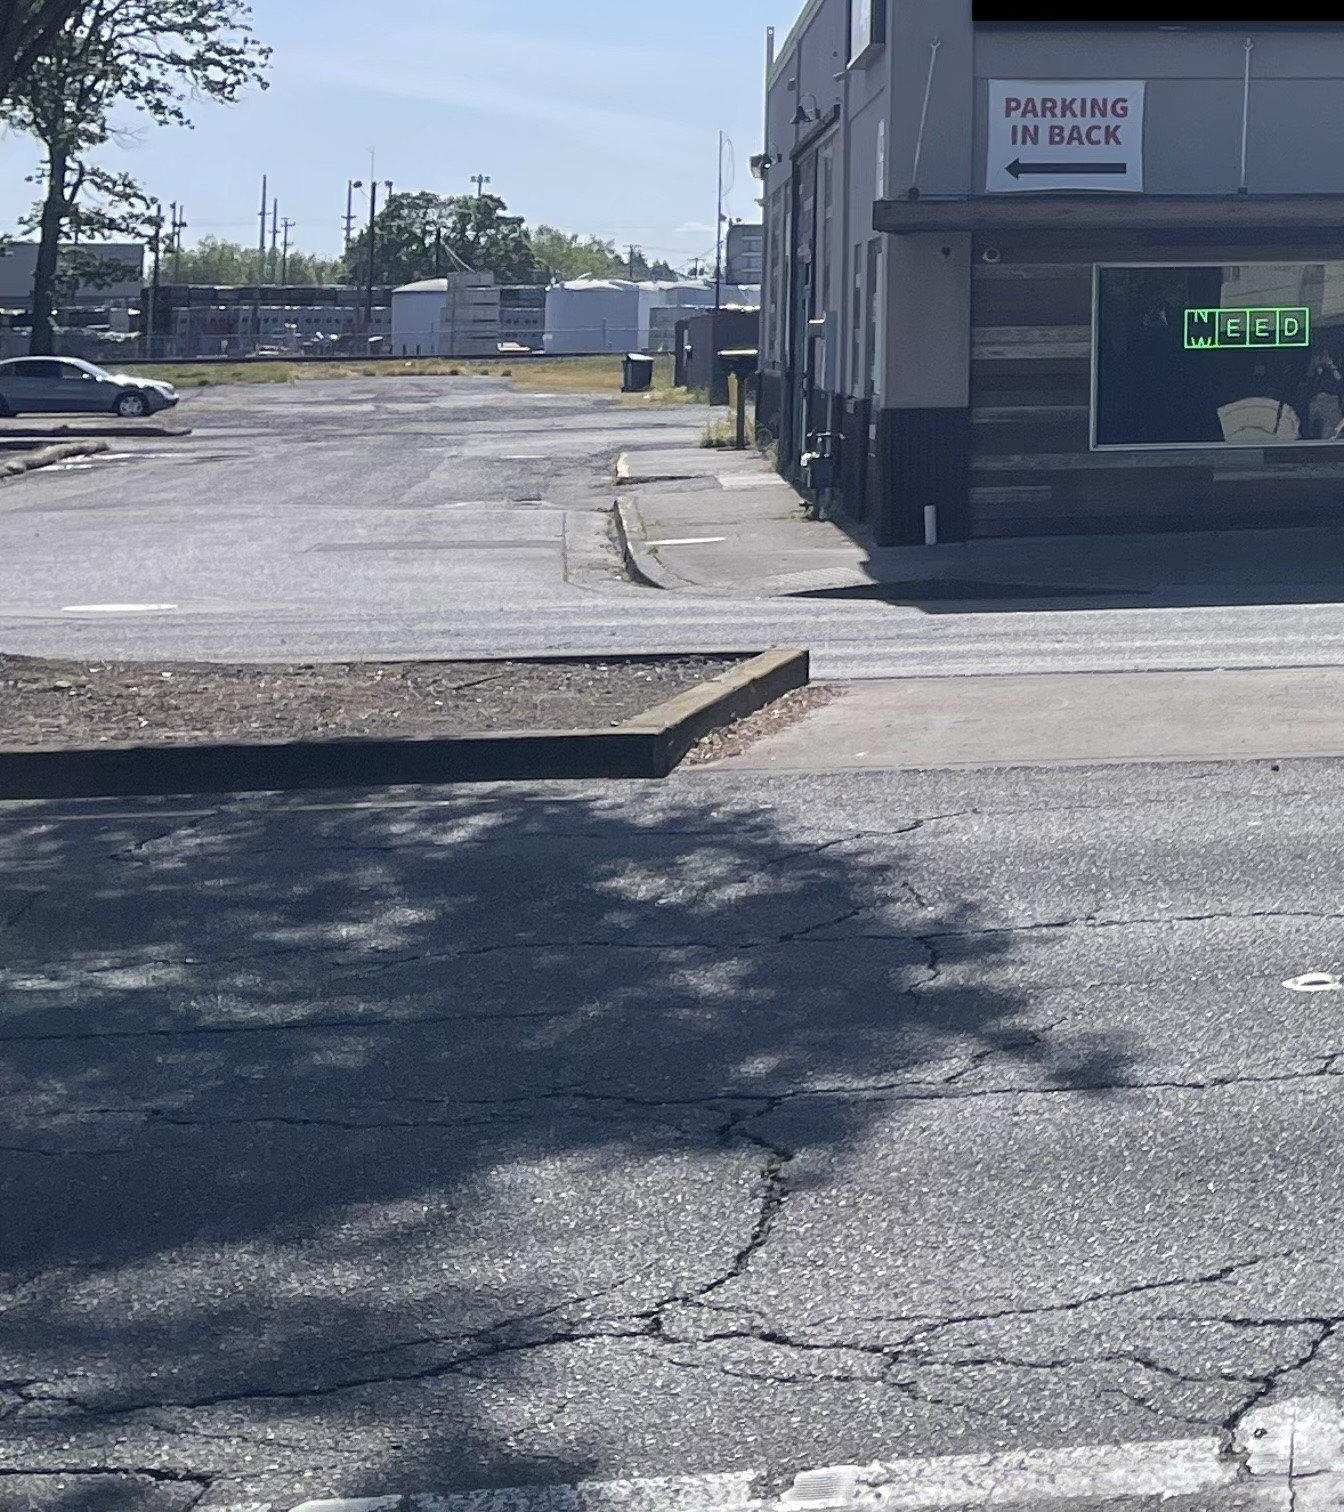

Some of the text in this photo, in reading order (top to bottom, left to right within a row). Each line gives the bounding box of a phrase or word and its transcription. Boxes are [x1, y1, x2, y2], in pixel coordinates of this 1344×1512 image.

[1004, 96, 1129, 119] PARKING
[1010, 124, 1122, 146] IN BACK
